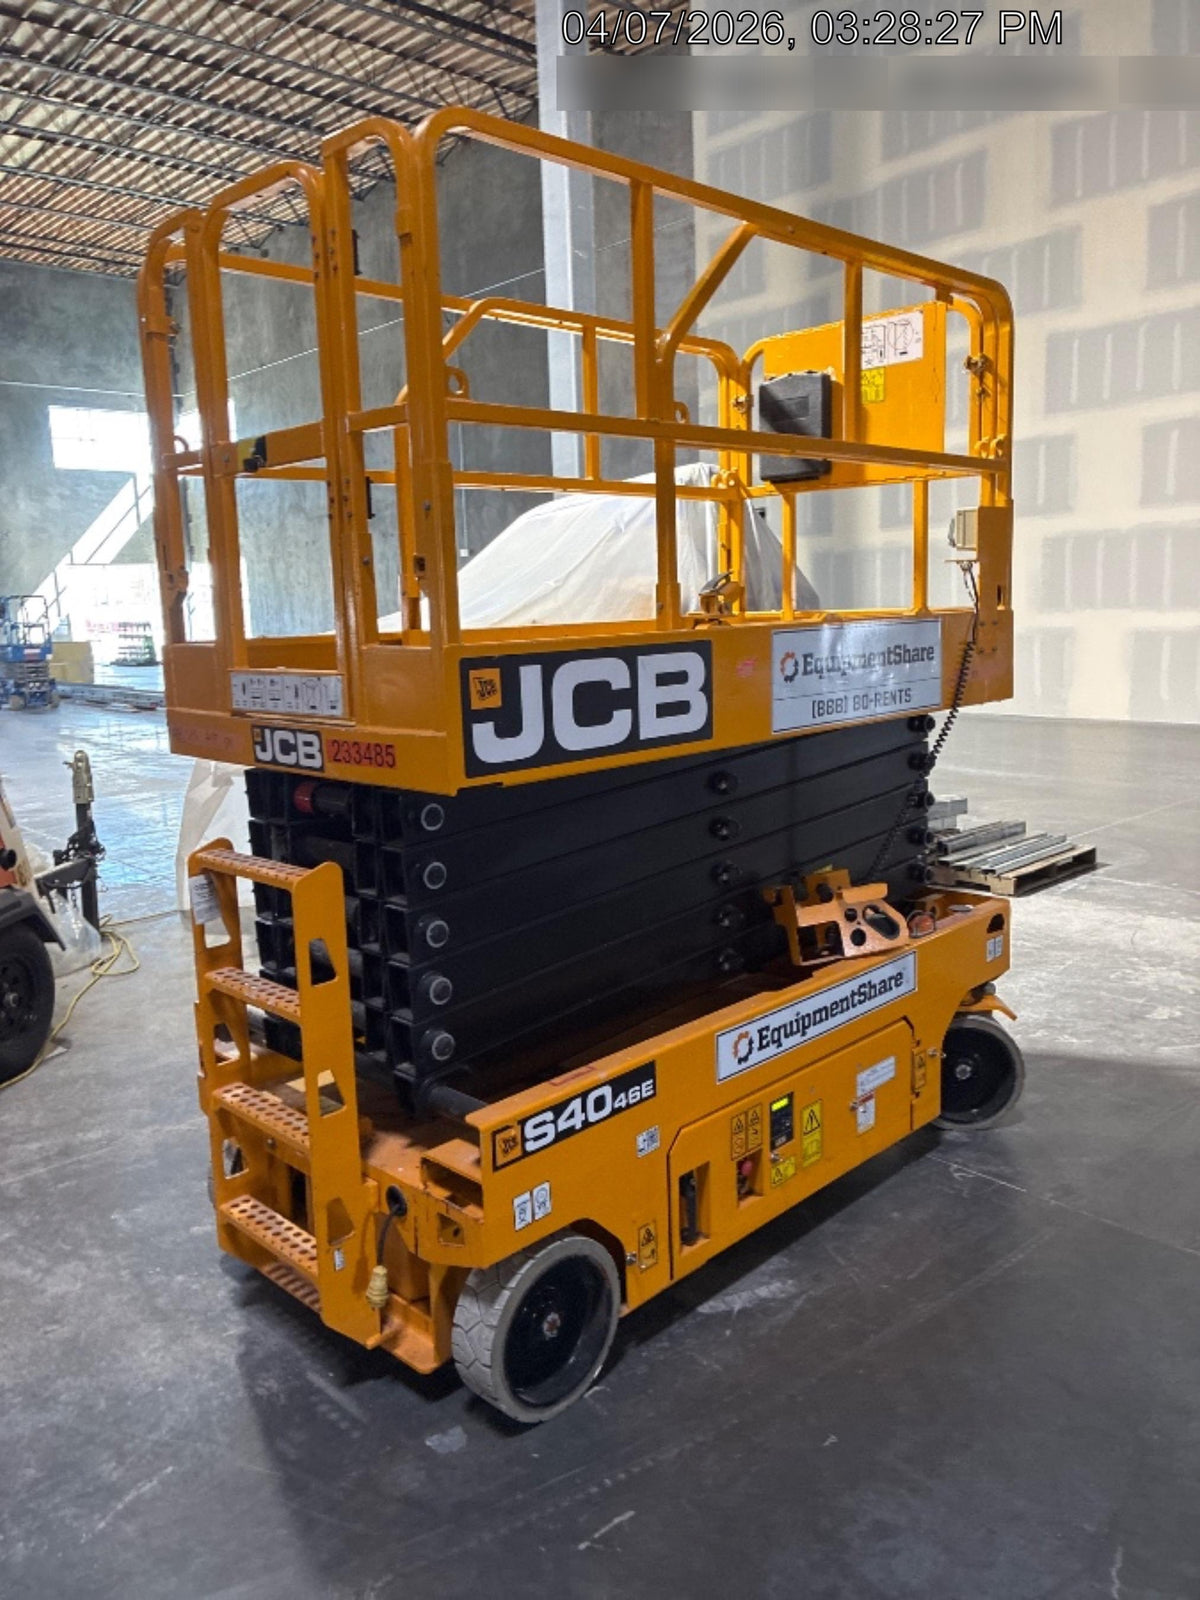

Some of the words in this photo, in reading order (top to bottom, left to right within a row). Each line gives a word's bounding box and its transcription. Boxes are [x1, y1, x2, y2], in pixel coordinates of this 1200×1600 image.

[472, 652, 708, 763] JCB
[254, 728, 322, 769] JCB
[330, 739, 396, 768] 233485
[757, 970, 904, 1051] EquipmentShare
